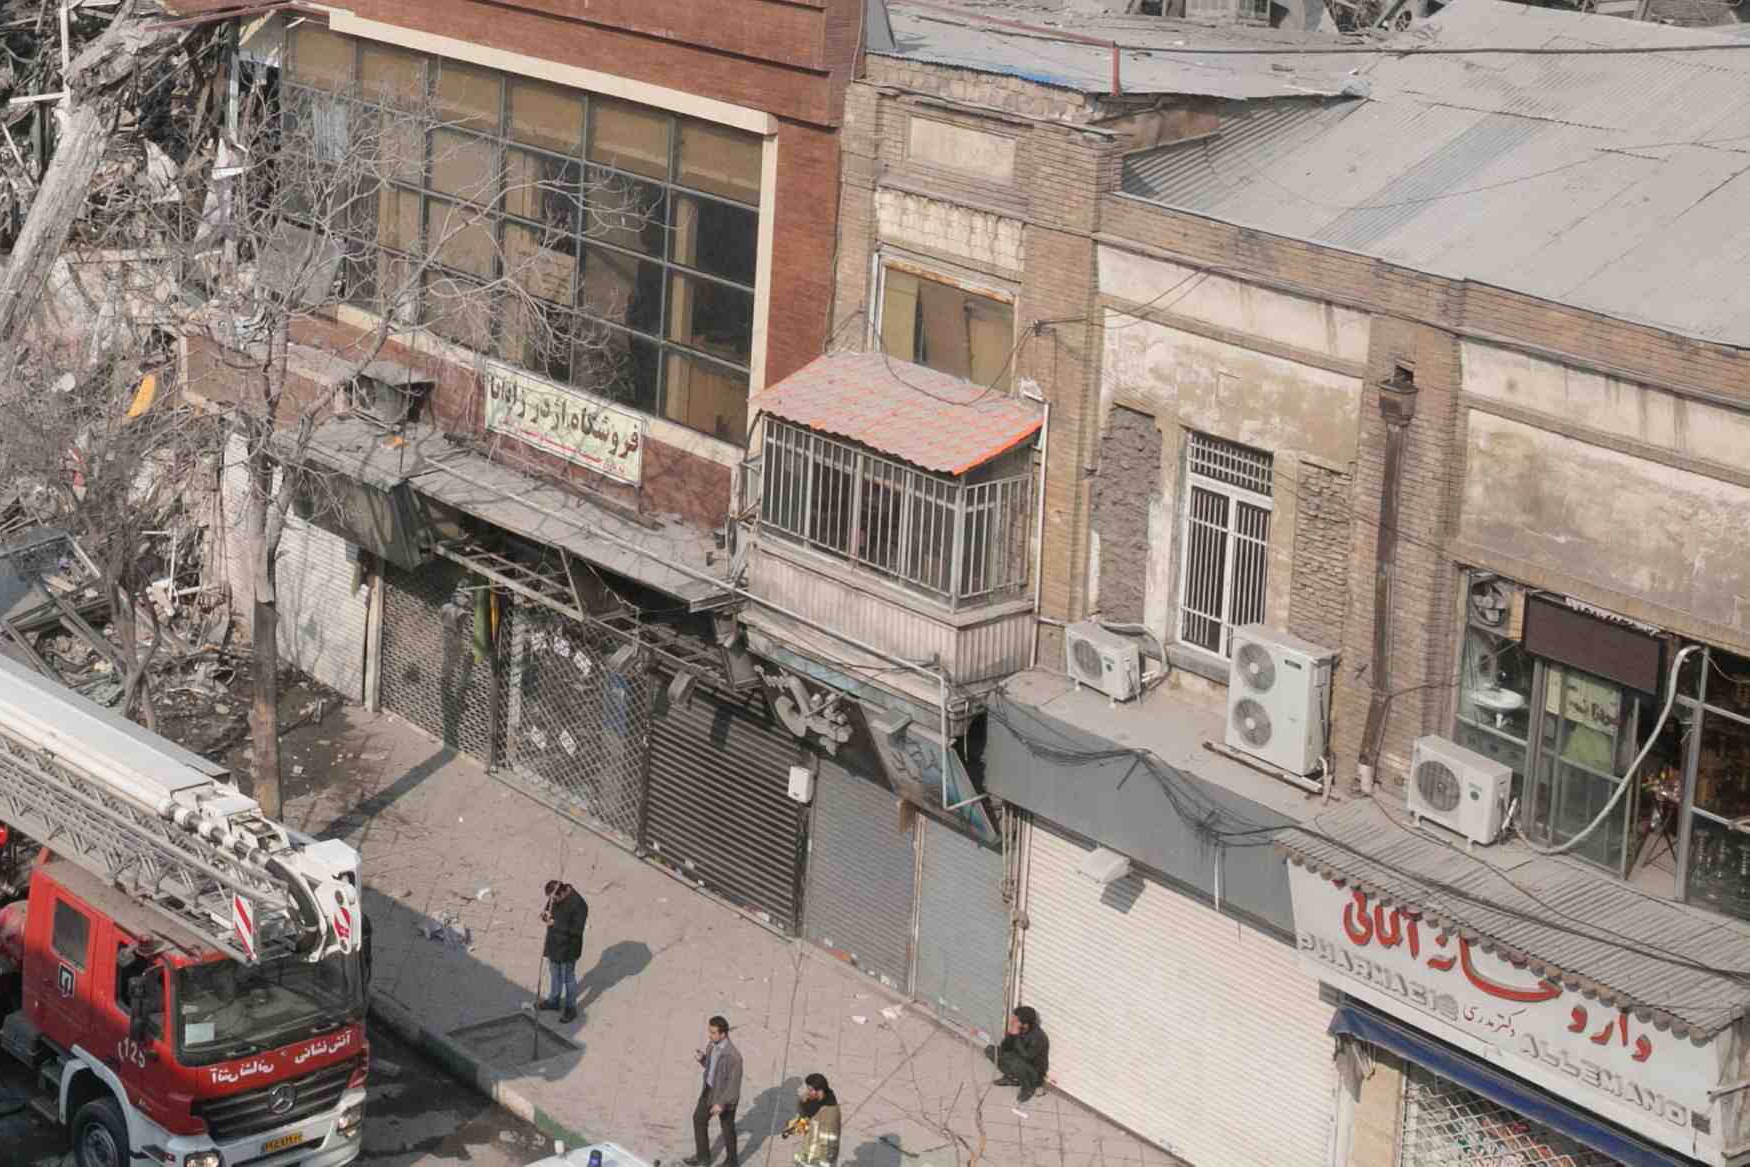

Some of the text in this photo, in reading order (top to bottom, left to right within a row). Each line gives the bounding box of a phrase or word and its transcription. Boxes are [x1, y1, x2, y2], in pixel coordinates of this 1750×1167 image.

[570, 407, 639, 459] فروشگاه
[293, 1030, 352, 1064] آتش نشانی
